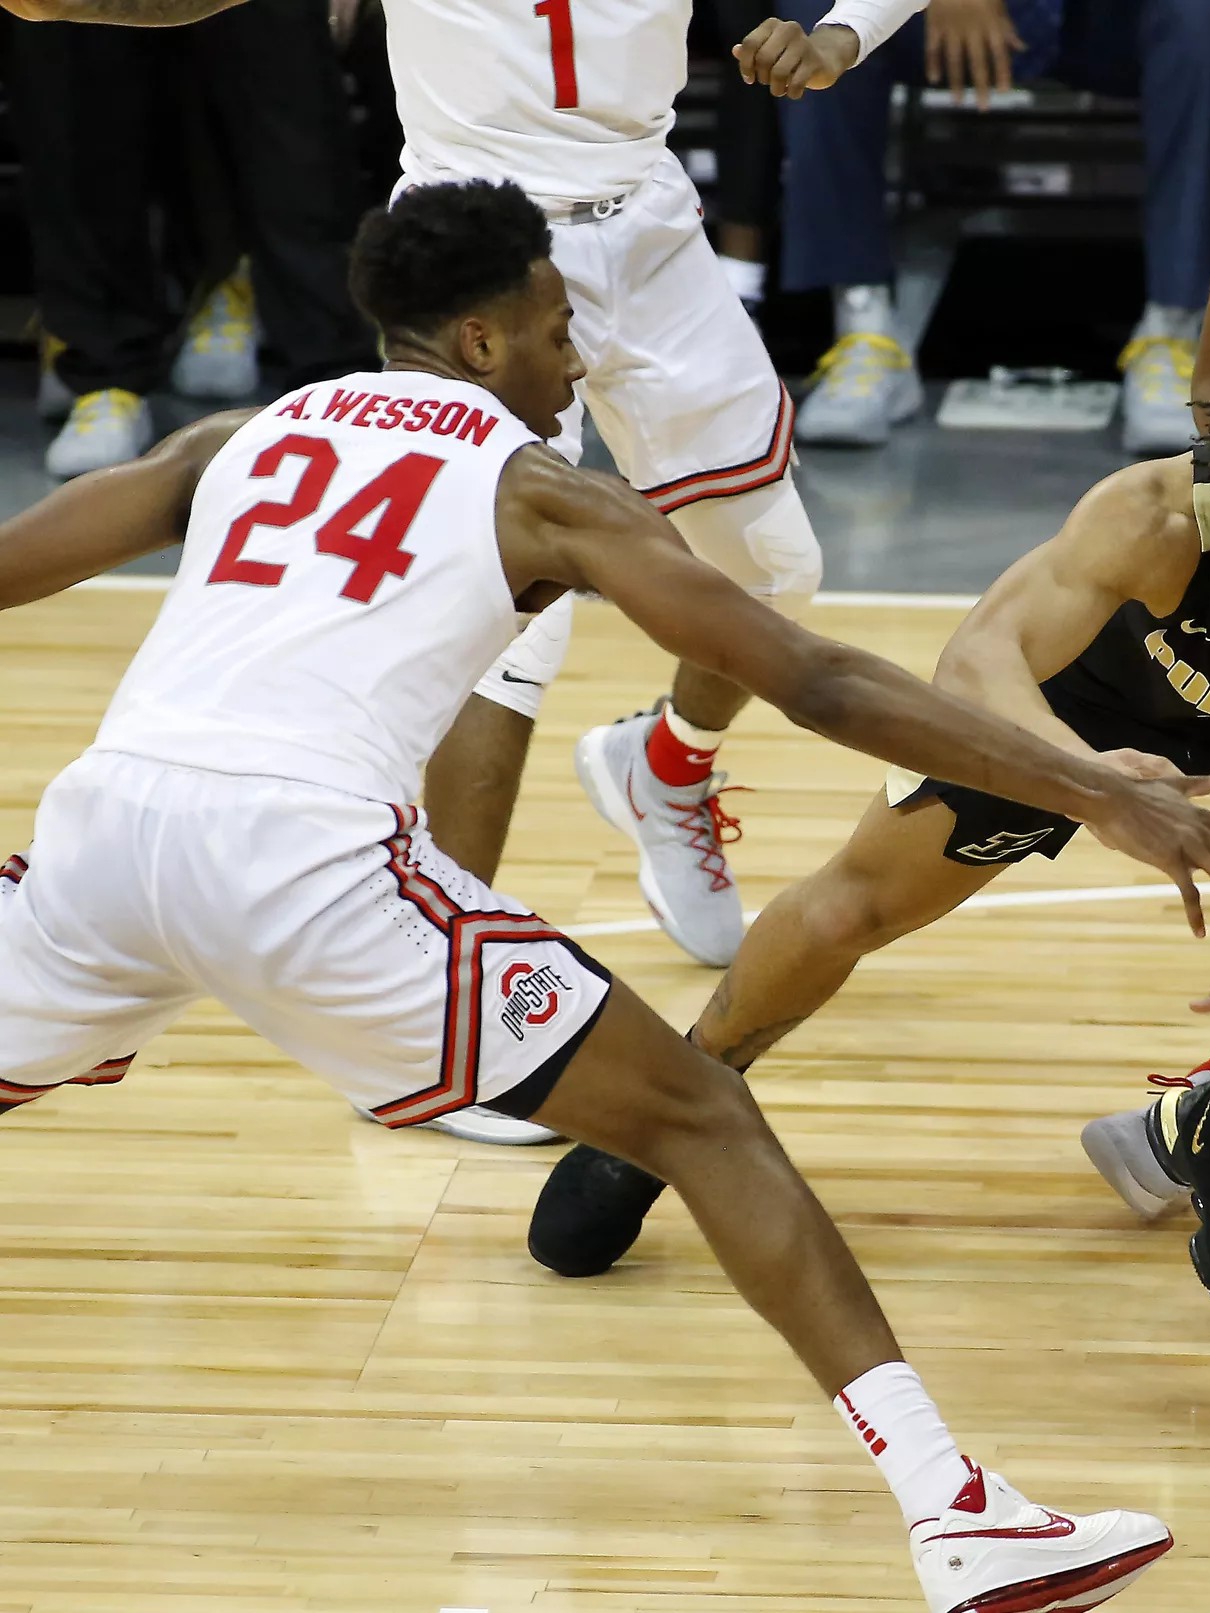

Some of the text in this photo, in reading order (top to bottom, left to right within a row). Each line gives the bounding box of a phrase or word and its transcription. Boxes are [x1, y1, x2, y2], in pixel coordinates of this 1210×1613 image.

[534, 0, 579, 110] 1
[276, 388, 500, 447] A. WESSON
[205, 433, 449, 605] 24
[501, 965, 574, 1042] OHIO STATE
